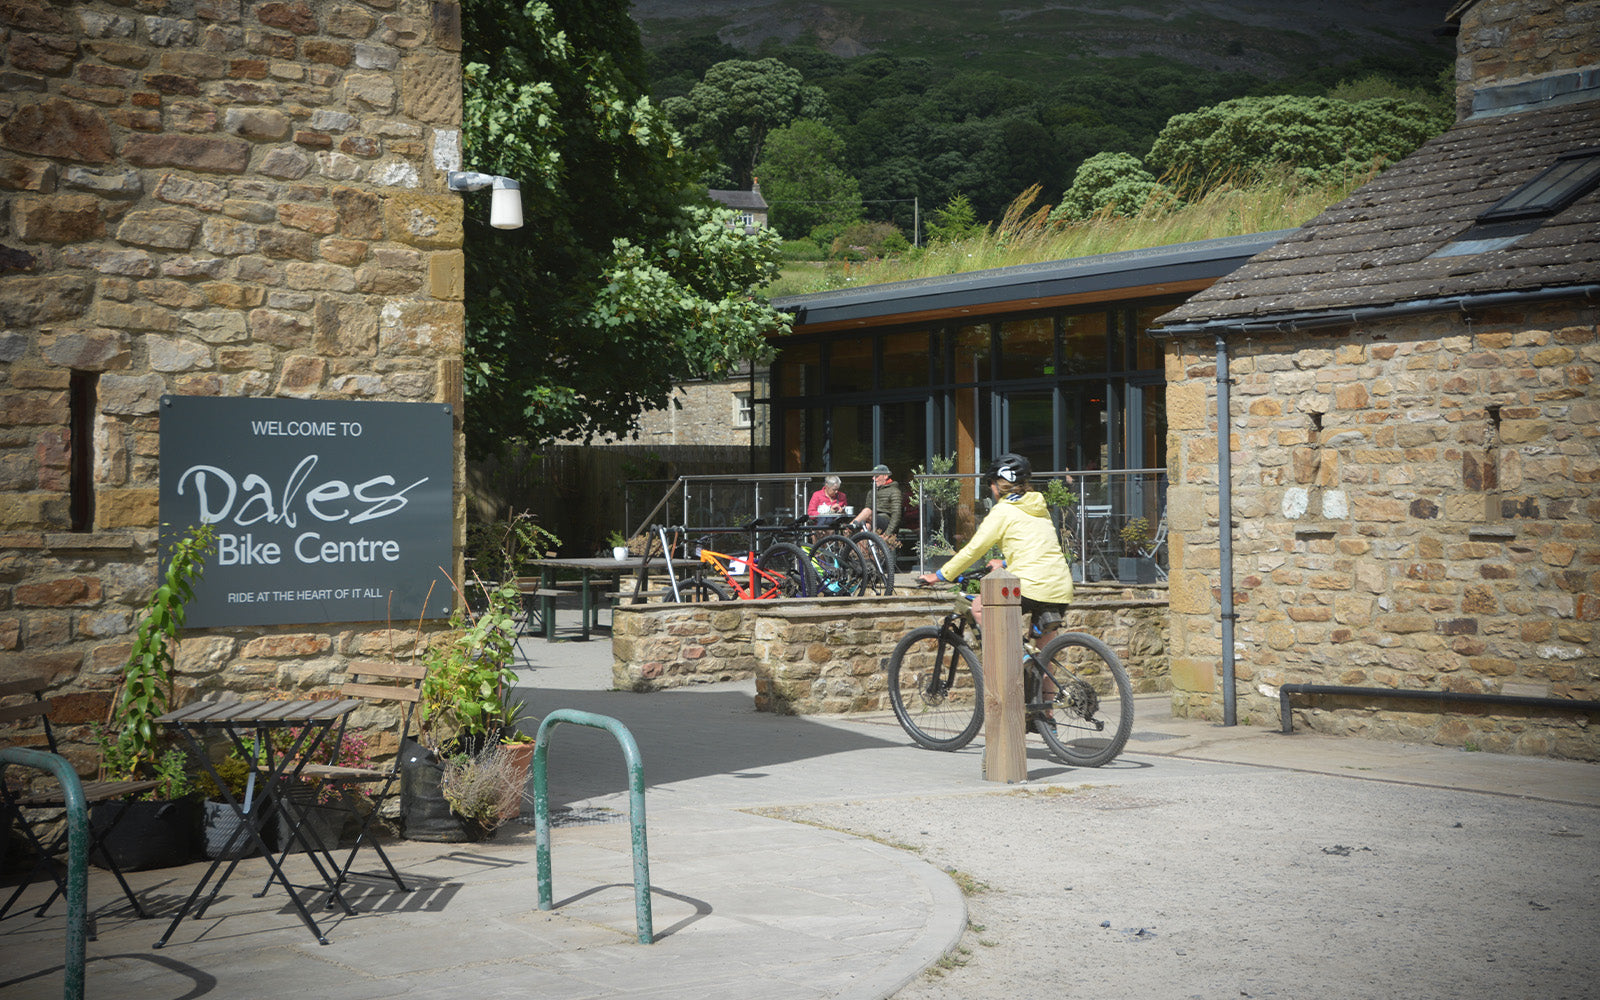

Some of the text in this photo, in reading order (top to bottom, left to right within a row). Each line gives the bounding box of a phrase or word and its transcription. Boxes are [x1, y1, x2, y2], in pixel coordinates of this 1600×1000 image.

[252, 421, 362, 436] WELCOME TO
[177, 455, 430, 528] Dales
[218, 532, 400, 565] Bike Centre
[227, 588, 383, 603] RIDE AT THE HEART OF IT ALL
